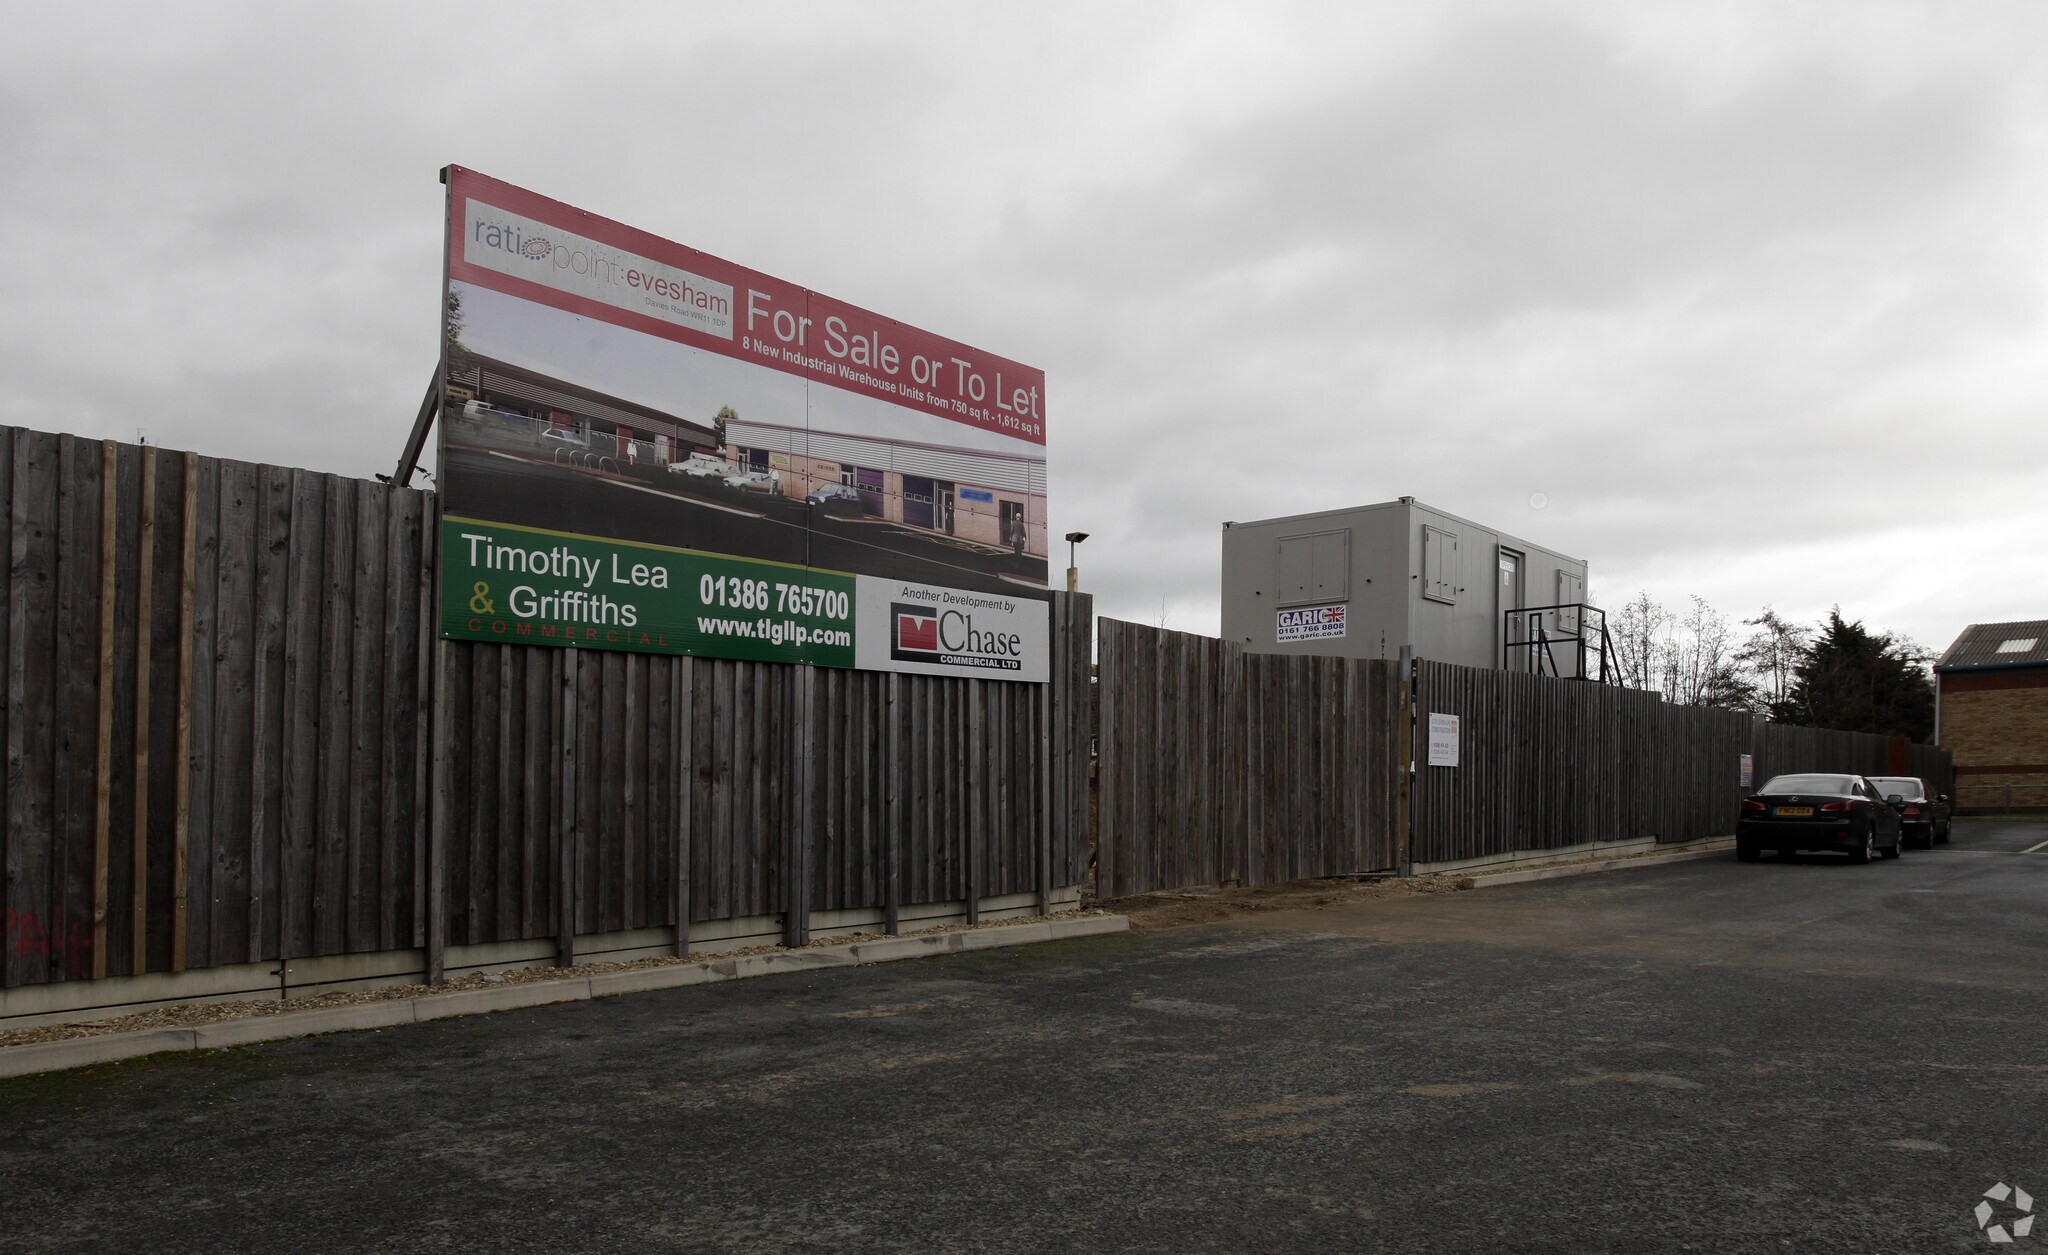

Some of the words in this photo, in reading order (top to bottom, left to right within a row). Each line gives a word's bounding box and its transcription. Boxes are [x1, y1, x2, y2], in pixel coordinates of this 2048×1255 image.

[645, 297, 669, 310] Davies
[671, 305, 689, 317] Road
[690, 311, 710, 323] WR11
[748, 289, 812, 346] For
[824, 316, 900, 374] Sale
[911, 355, 942, 388] or
[951, 357, 986, 402] To
[996, 372, 1038, 419] Let
[742, 335, 750, 350] 8
[753, 339, 780, 358] New
[782, 347, 836, 375] Industrial
[839, 365, 897, 394] Warehouse
[899, 382, 924, 402] Units
[927, 391, 949, 409] from
[951, 398, 967, 415] 750
[969, 406, 980, 422] sq
[982, 407, 990, 421] ft
[997, 412, 1020, 433] 1,612
[1021, 420, 1032, 436] sq
[1033, 422, 1041, 436] ft
[461, 533, 600, 588] Timothy
[612, 553, 669, 589] Lea
[469, 581, 495, 615] &
[509, 585, 637, 627] Griffiths
[700, 574, 769, 611] 01386
[775, 583, 849, 620] 765700
[902, 586, 941, 603] Another
[943, 592, 1002, 611] Development
[1003, 601, 1016, 614] by
[468, 618, 668, 647] COMMERCIAL
[697, 616, 851, 647] www.tlgllp.com
[939, 609, 1021, 657] Chase
[1278, 627, 1299, 635] 0161
[1321, 622, 1344, 631] 8808
[1279, 609, 1332, 627] GARIC
[1278, 630, 1344, 641] www.garic.co.uk
[940, 655, 1000, 668] COMMERCIAL
[1001, 660, 1019, 670] LTD
